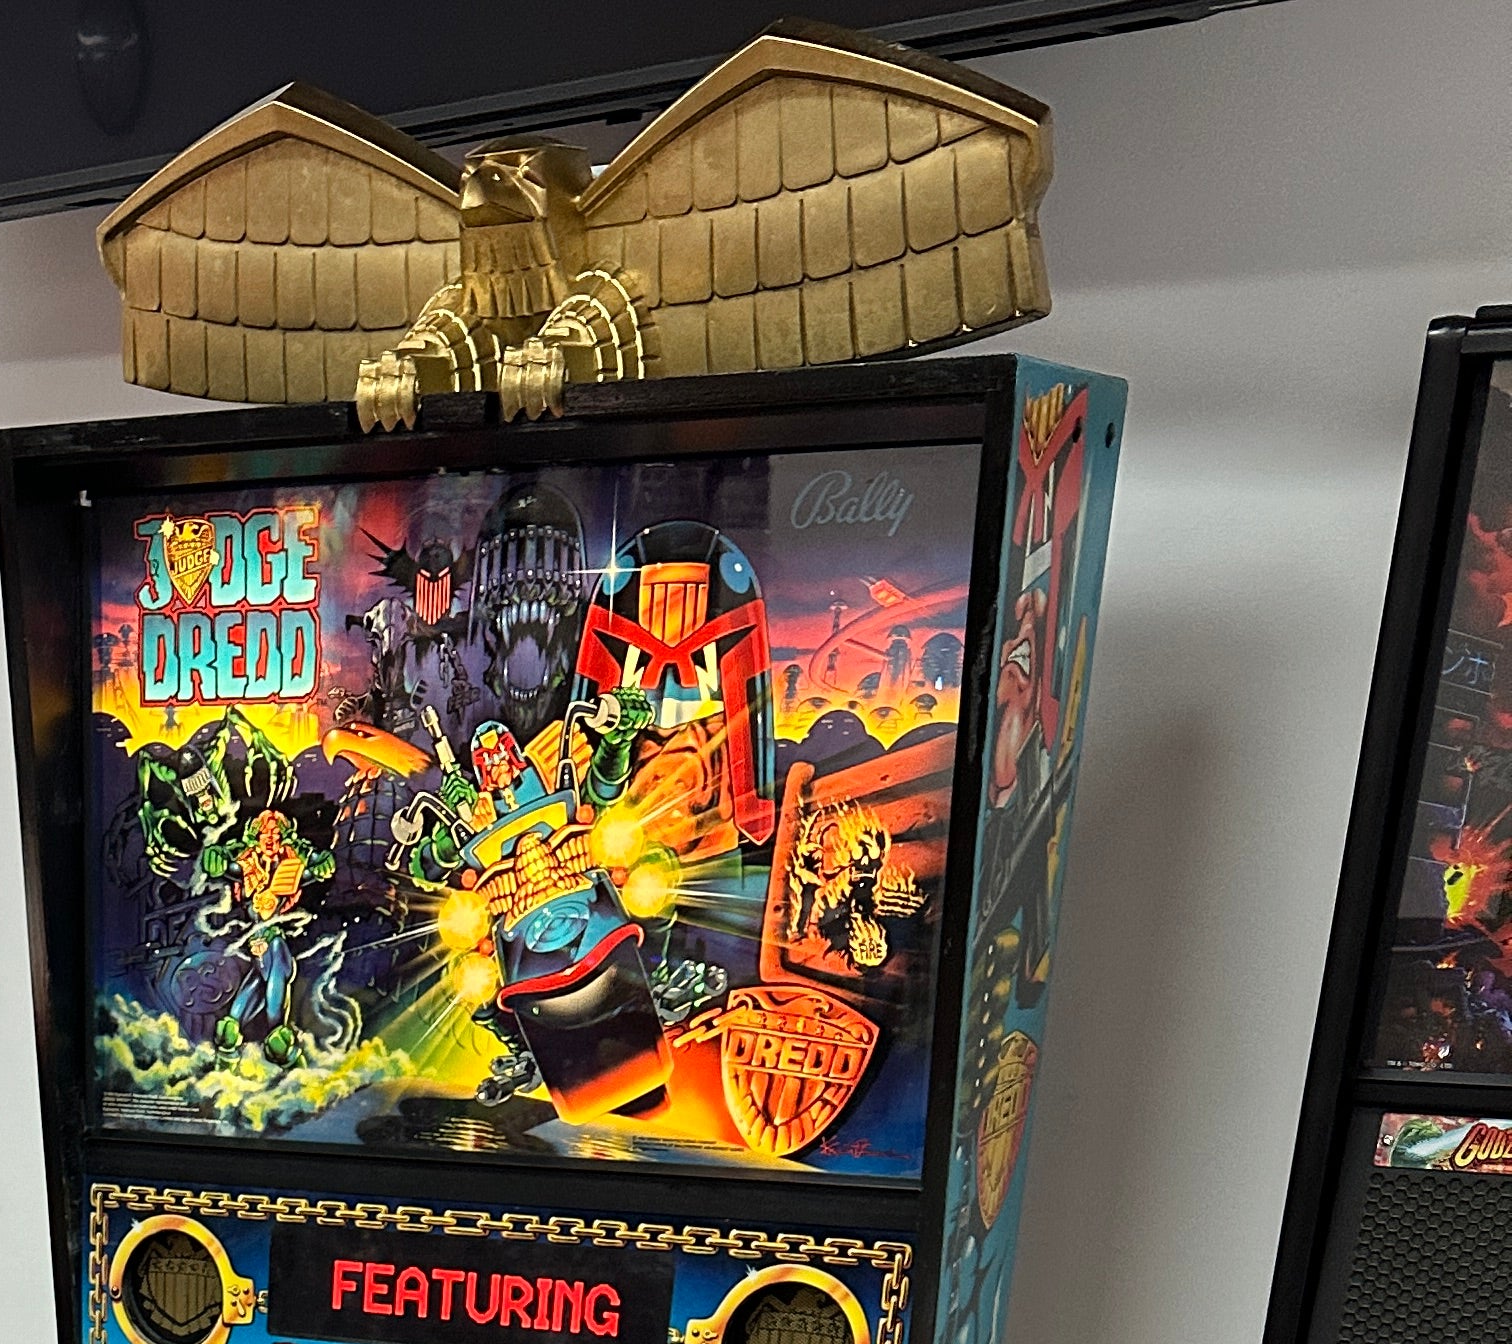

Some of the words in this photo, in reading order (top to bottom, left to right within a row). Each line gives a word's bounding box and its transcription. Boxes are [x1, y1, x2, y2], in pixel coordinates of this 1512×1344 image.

[790, 470, 915, 537] Bally
[173, 549, 211, 575] JUDGE
[142, 610, 317, 701] DREDD
[727, 1030, 869, 1081] DREDD
[331, 1259, 621, 1338] FEATURING
